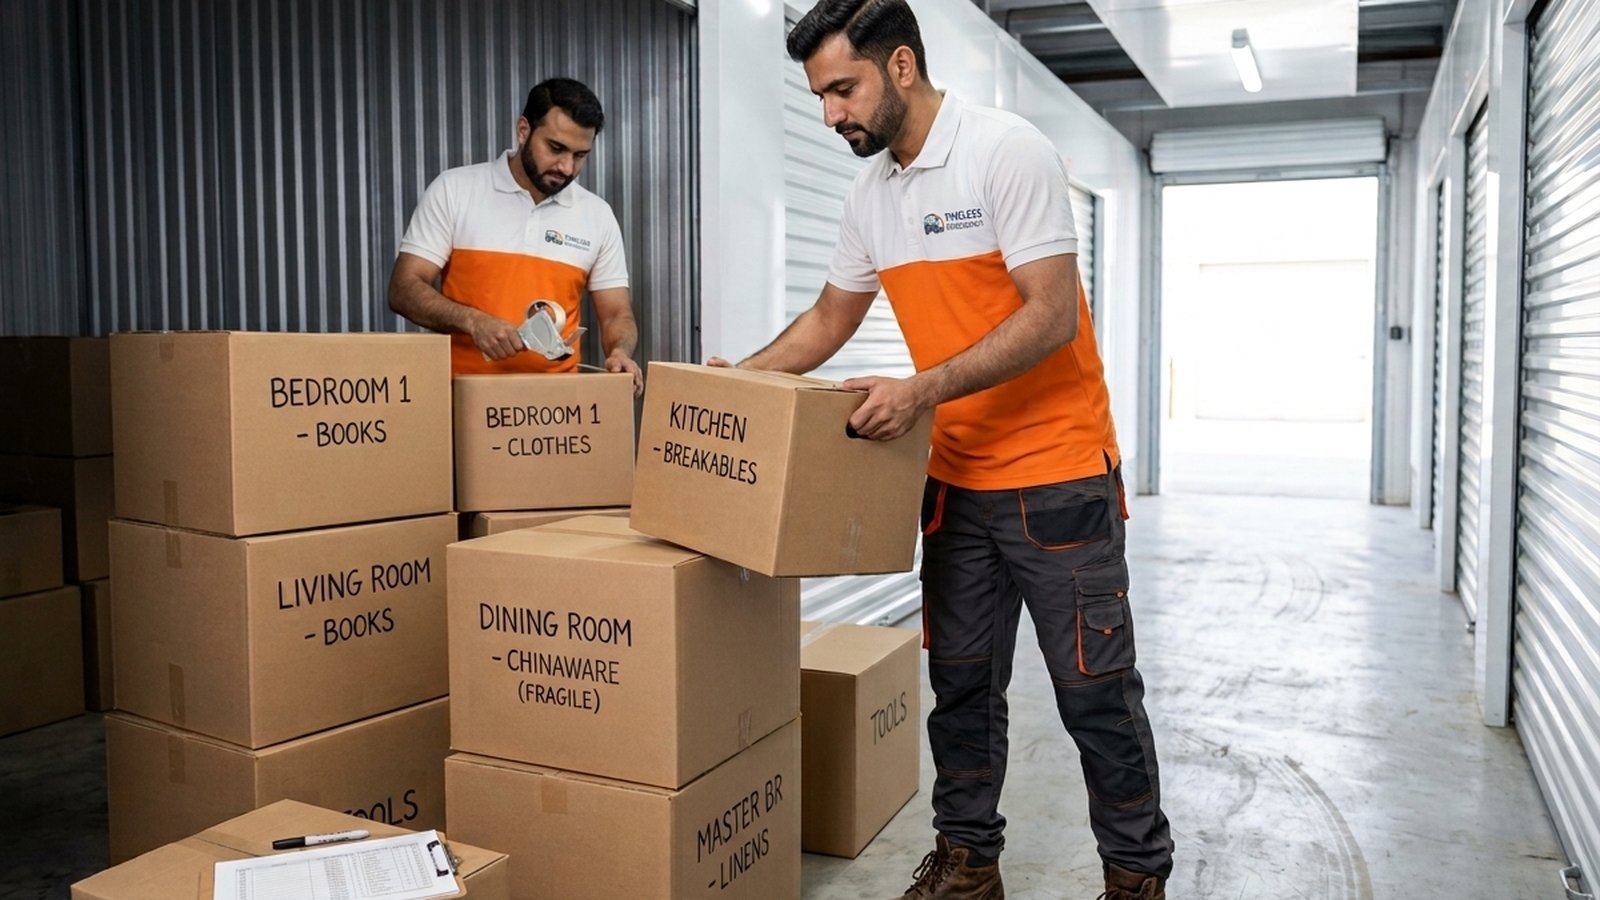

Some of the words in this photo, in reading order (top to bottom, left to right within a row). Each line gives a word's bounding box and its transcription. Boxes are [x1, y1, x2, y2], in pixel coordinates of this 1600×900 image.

[271, 376, 389, 408] BEDROOM
[400, 375, 411, 403] 1
[486, 404, 581, 428] BEDROOM
[590, 403, 601, 425] 1
[669, 401, 747, 443] KITCHEN
[278, 569, 362, 609] LIVING
[372, 557, 431, 593] ROOM
[479, 603, 558, 637] DINING
[568, 612, 632, 647] ROOM
[518, 680, 601, 714] (FRAGILE)
[870, 691, 907, 745] TOOLS
[344, 789, 418, 825] OLS
[697, 790, 760, 862] MASTER
[765, 774, 783, 813] BR
